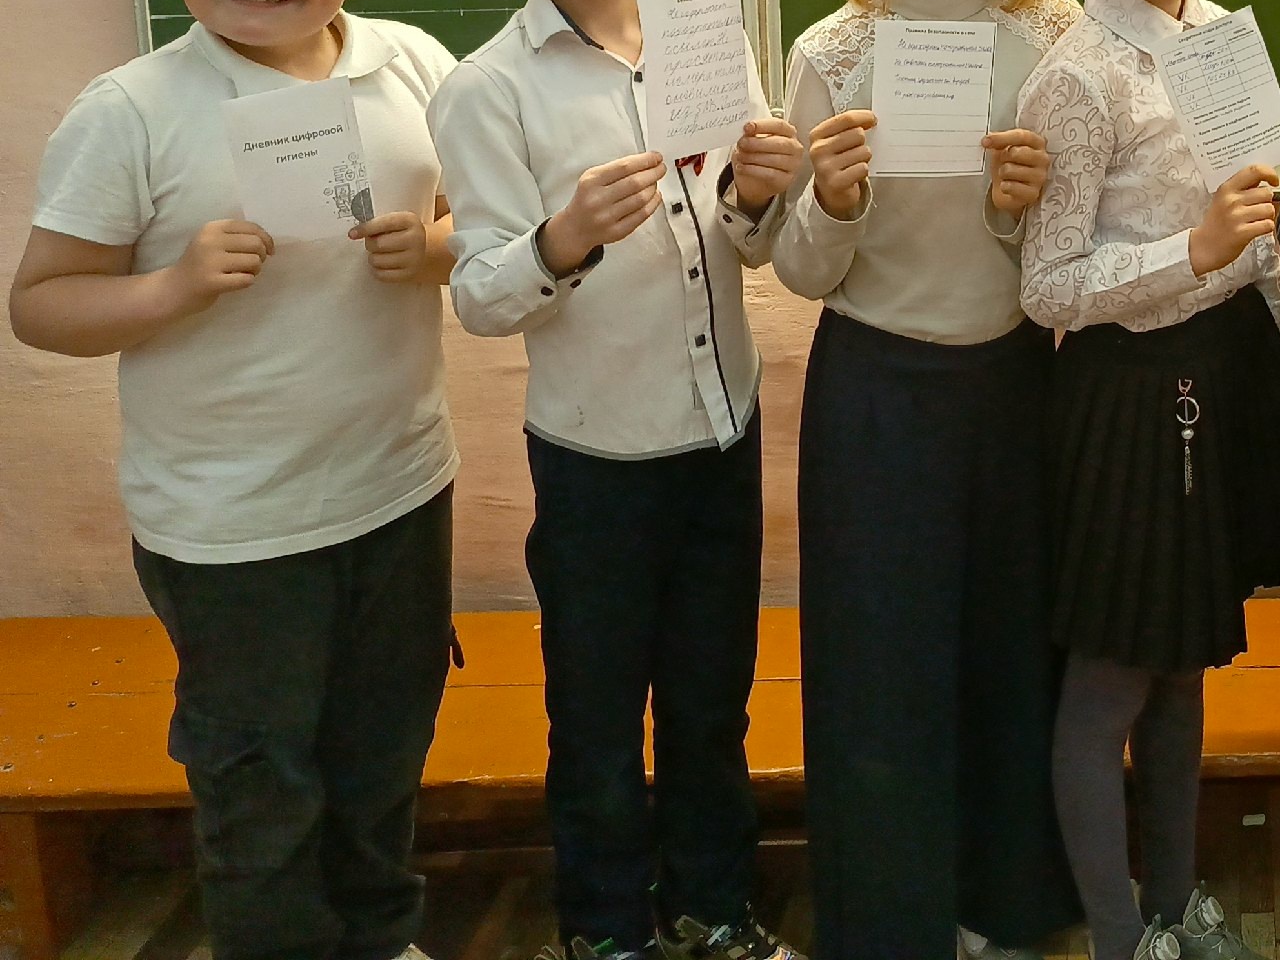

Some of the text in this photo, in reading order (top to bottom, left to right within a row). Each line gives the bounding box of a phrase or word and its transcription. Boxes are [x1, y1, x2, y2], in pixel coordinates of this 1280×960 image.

[243, 124, 343, 153] Дневник цифровой
[276, 149, 318, 164] гигиены
